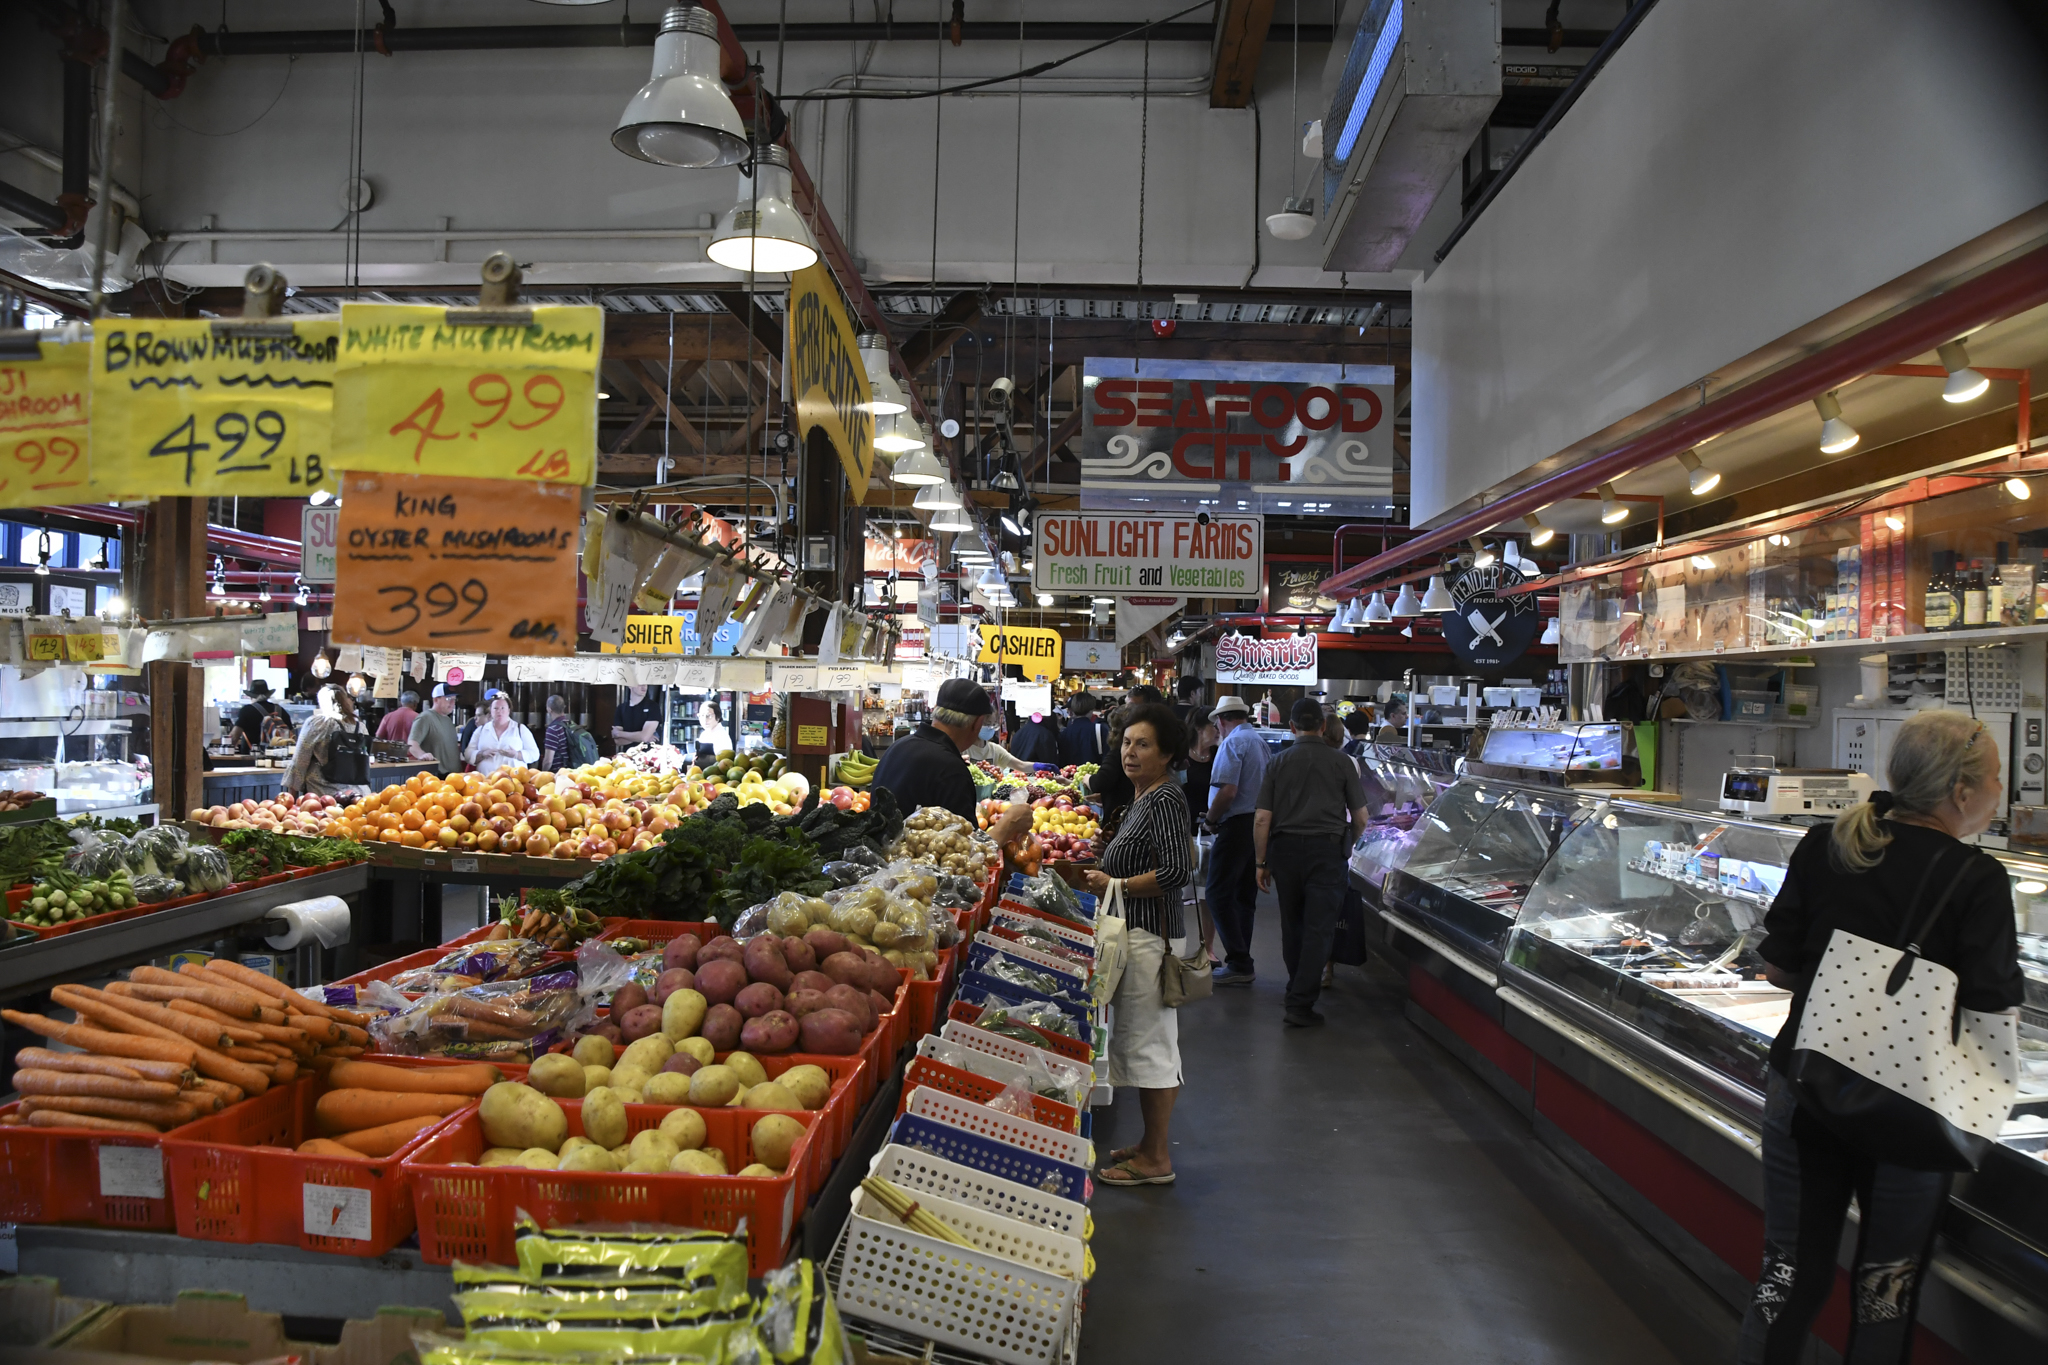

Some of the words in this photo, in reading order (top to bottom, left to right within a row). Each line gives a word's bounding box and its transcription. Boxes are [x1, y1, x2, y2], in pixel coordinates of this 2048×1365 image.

[346, 325, 424, 352] WHITE
[795, 291, 820, 399] HERB
[821, 304, 870, 479] CENTRE
[1093, 380, 1382, 433] SEAFOOD
[1172, 432, 1308, 481] CITY
[395, 491, 457, 517] KING
[348, 527, 429, 548] OYSTER
[442, 526, 572, 550] MUSHROOMS
[1043, 520, 1164, 558] SUNLIGHT
[1173, 521, 1253, 560] FARMS
[1050, 562, 1087, 585] Fresh
[1094, 563, 1132, 586] Fruit
[1139, 565, 1162, 586] and
[1169, 564, 1245, 588] Vegetables
[622, 623, 673, 645] SHIER
[990, 635, 1055, 657] CASHIER
